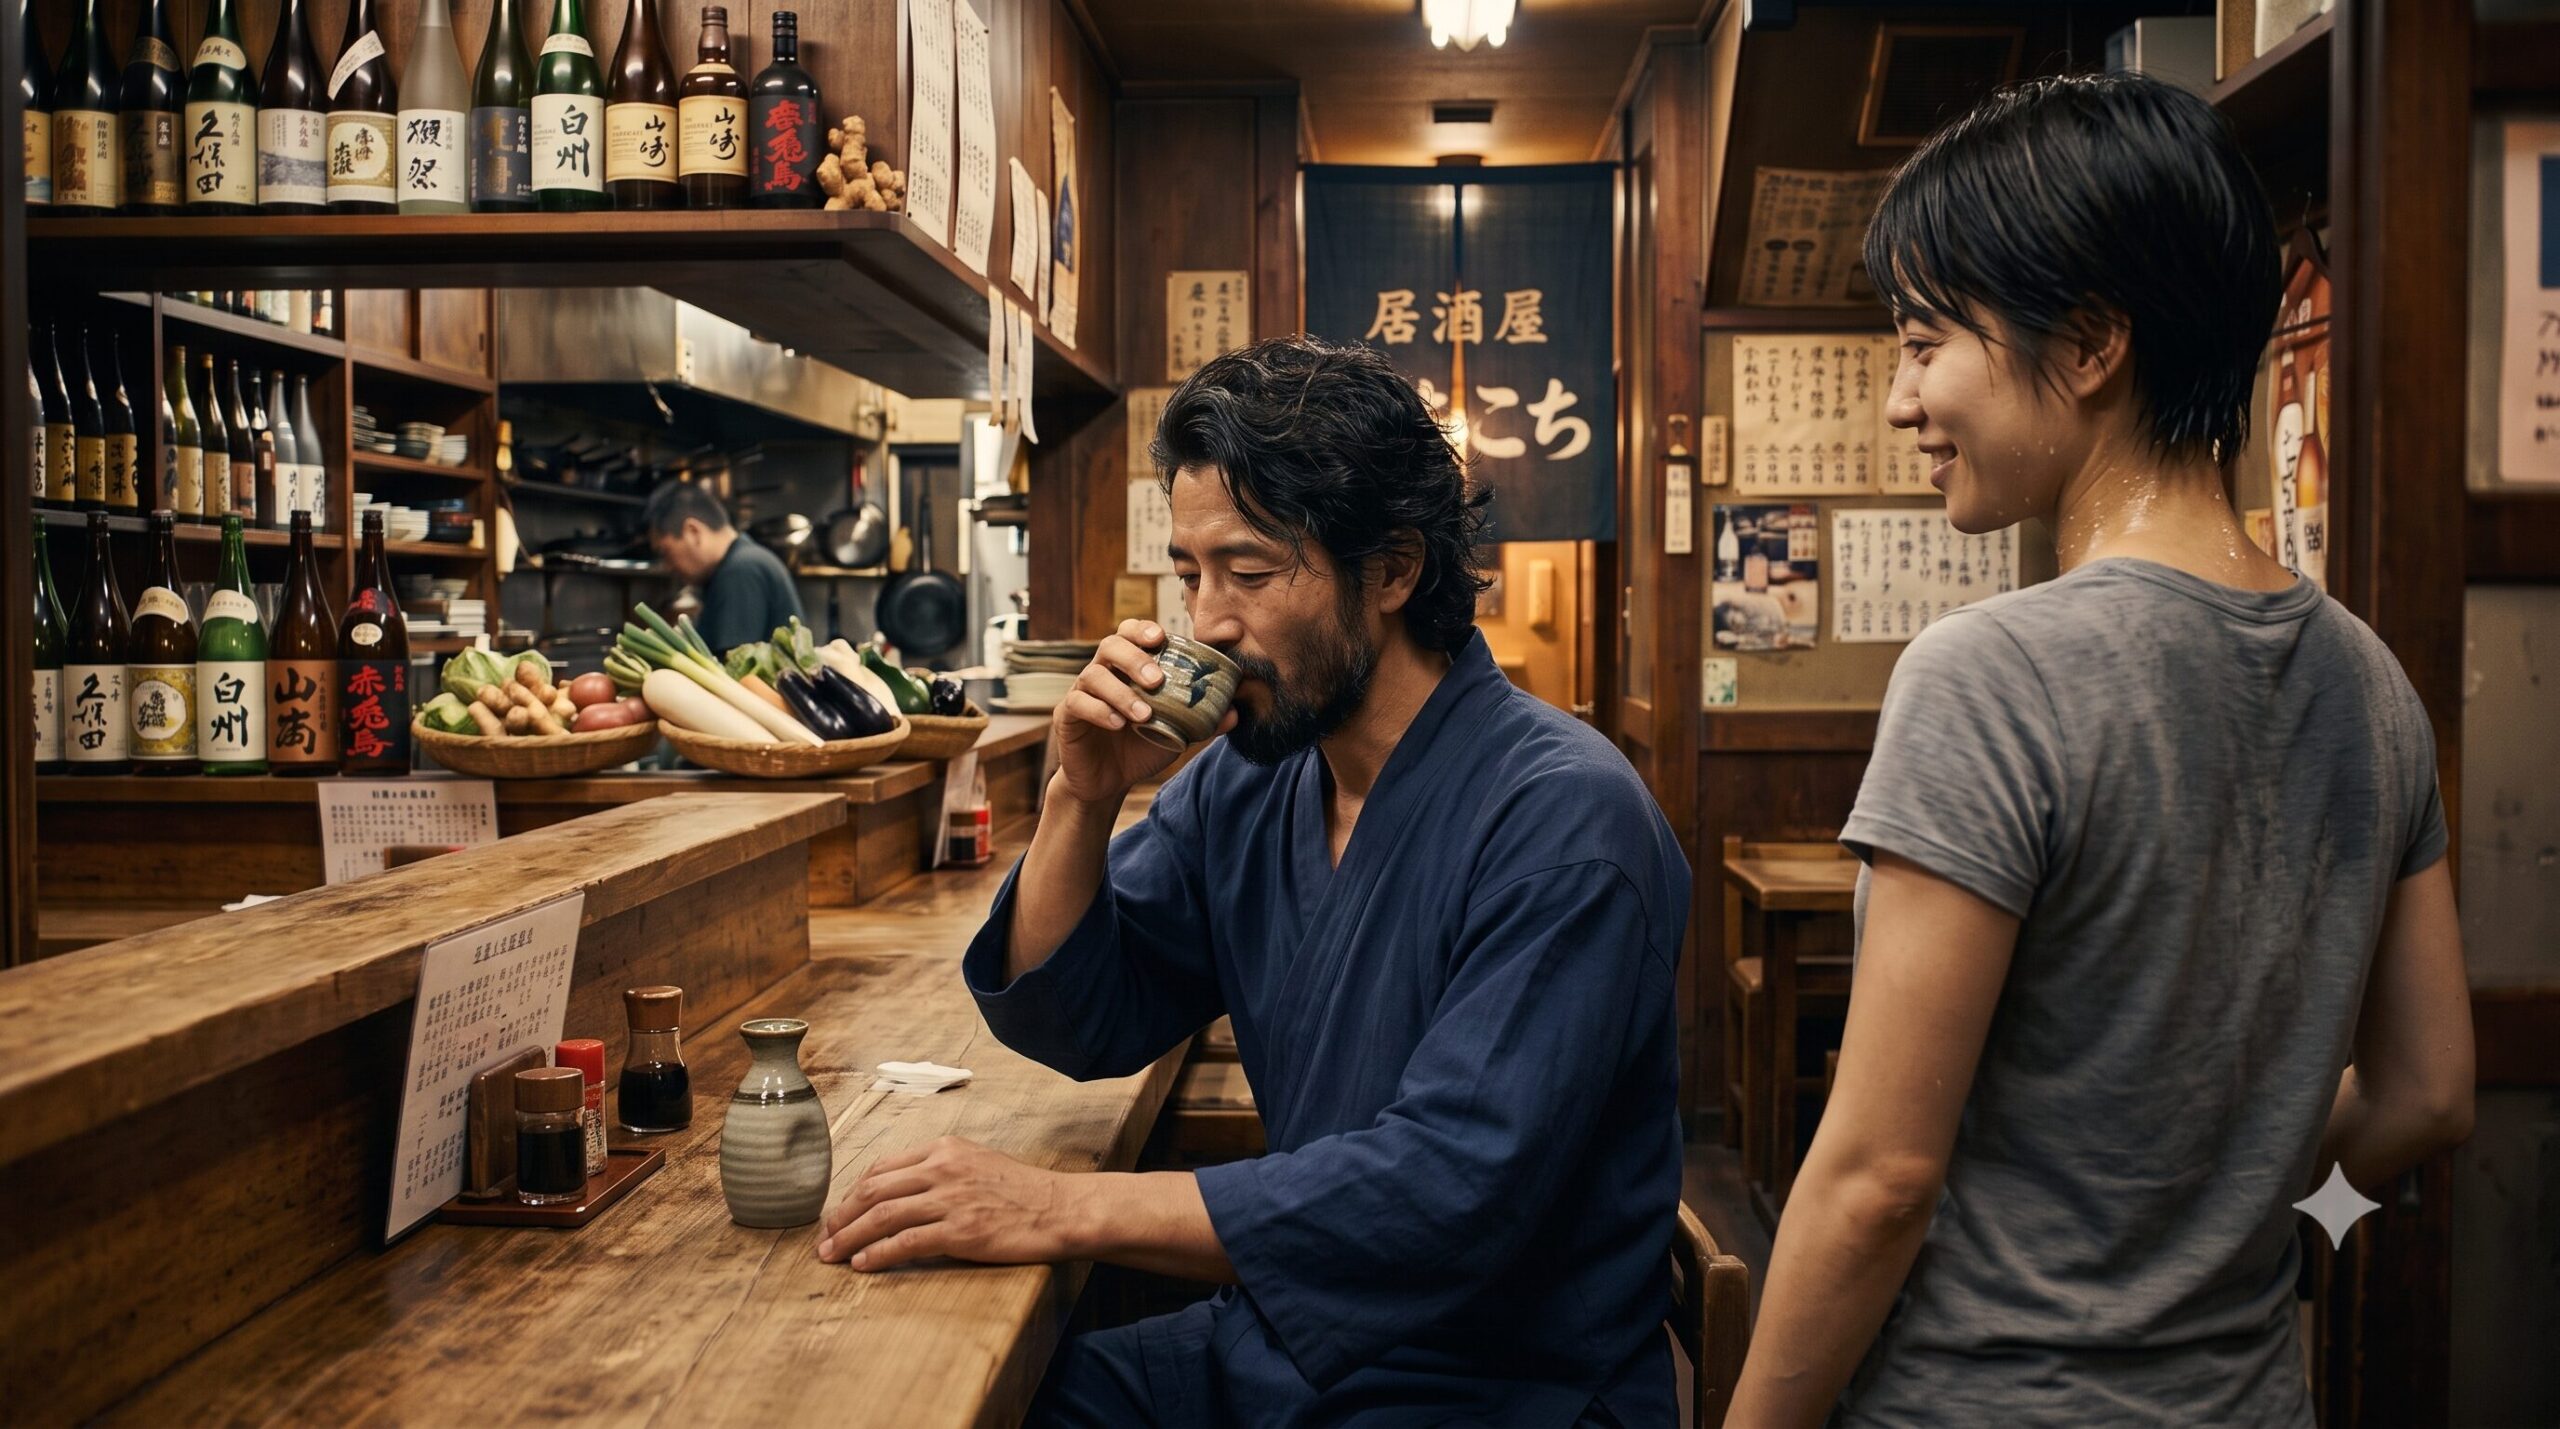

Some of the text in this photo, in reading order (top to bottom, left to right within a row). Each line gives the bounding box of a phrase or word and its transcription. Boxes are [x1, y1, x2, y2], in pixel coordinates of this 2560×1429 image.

[189, 109, 225, 195] 久保田
[556, 104, 590, 178] 白州
[1364, 288, 1548, 345] 居酒屋
[72, 672, 108, 750] 久保田
[211, 671, 249, 748] 白州
